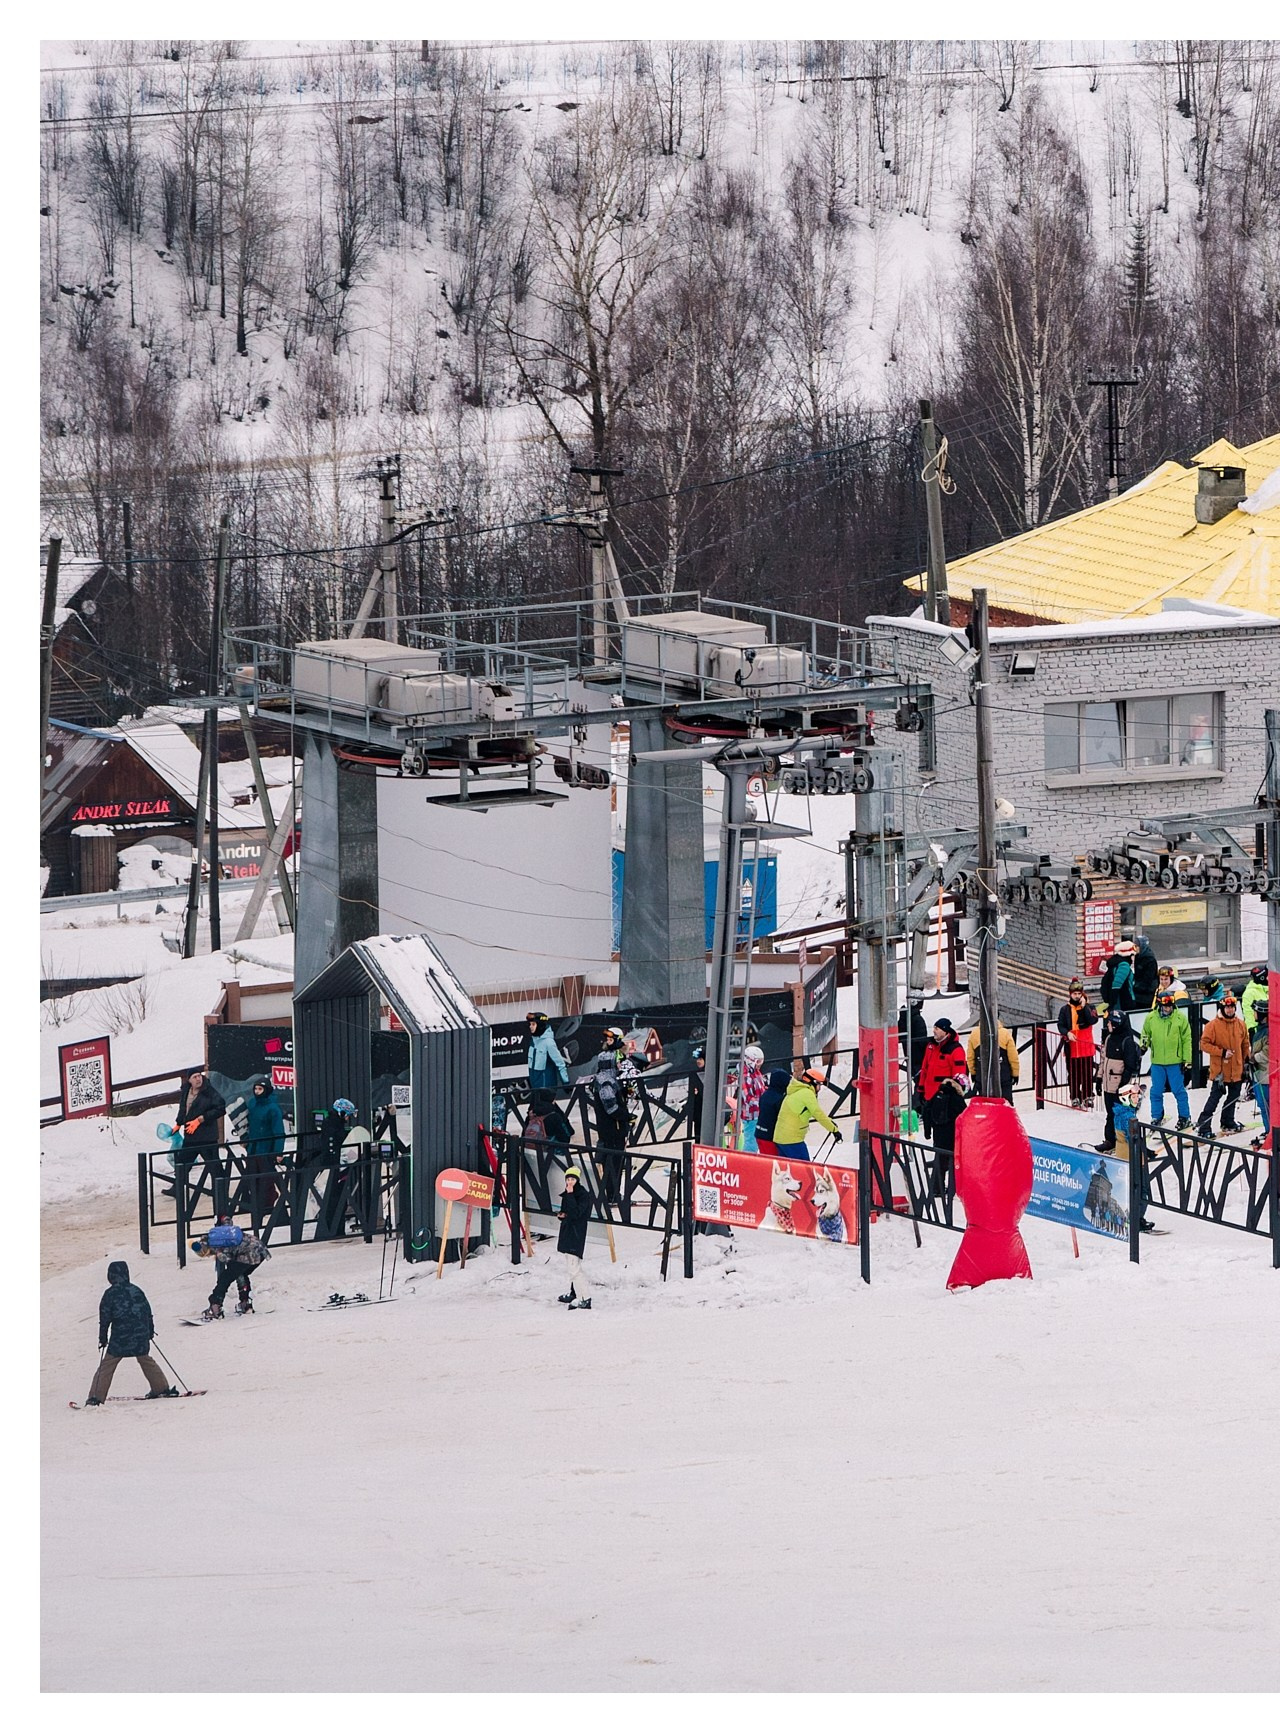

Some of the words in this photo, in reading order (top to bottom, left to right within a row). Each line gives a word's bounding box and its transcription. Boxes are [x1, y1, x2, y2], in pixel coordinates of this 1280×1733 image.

[754, 782, 760, 792] 5
[71, 803, 122, 821] ANDRY
[124, 799, 171, 816] STEAK
[696, 1151, 727, 1169] ДОМ
[1033, 1156, 1071, 1174] КСКУРСИЯ
[696, 1167, 740, 1188] ХАСКИ
[1033, 1169, 1049, 1183] ДЦЕ
[1051, 1172, 1083, 1190] ПАРМЫ»
